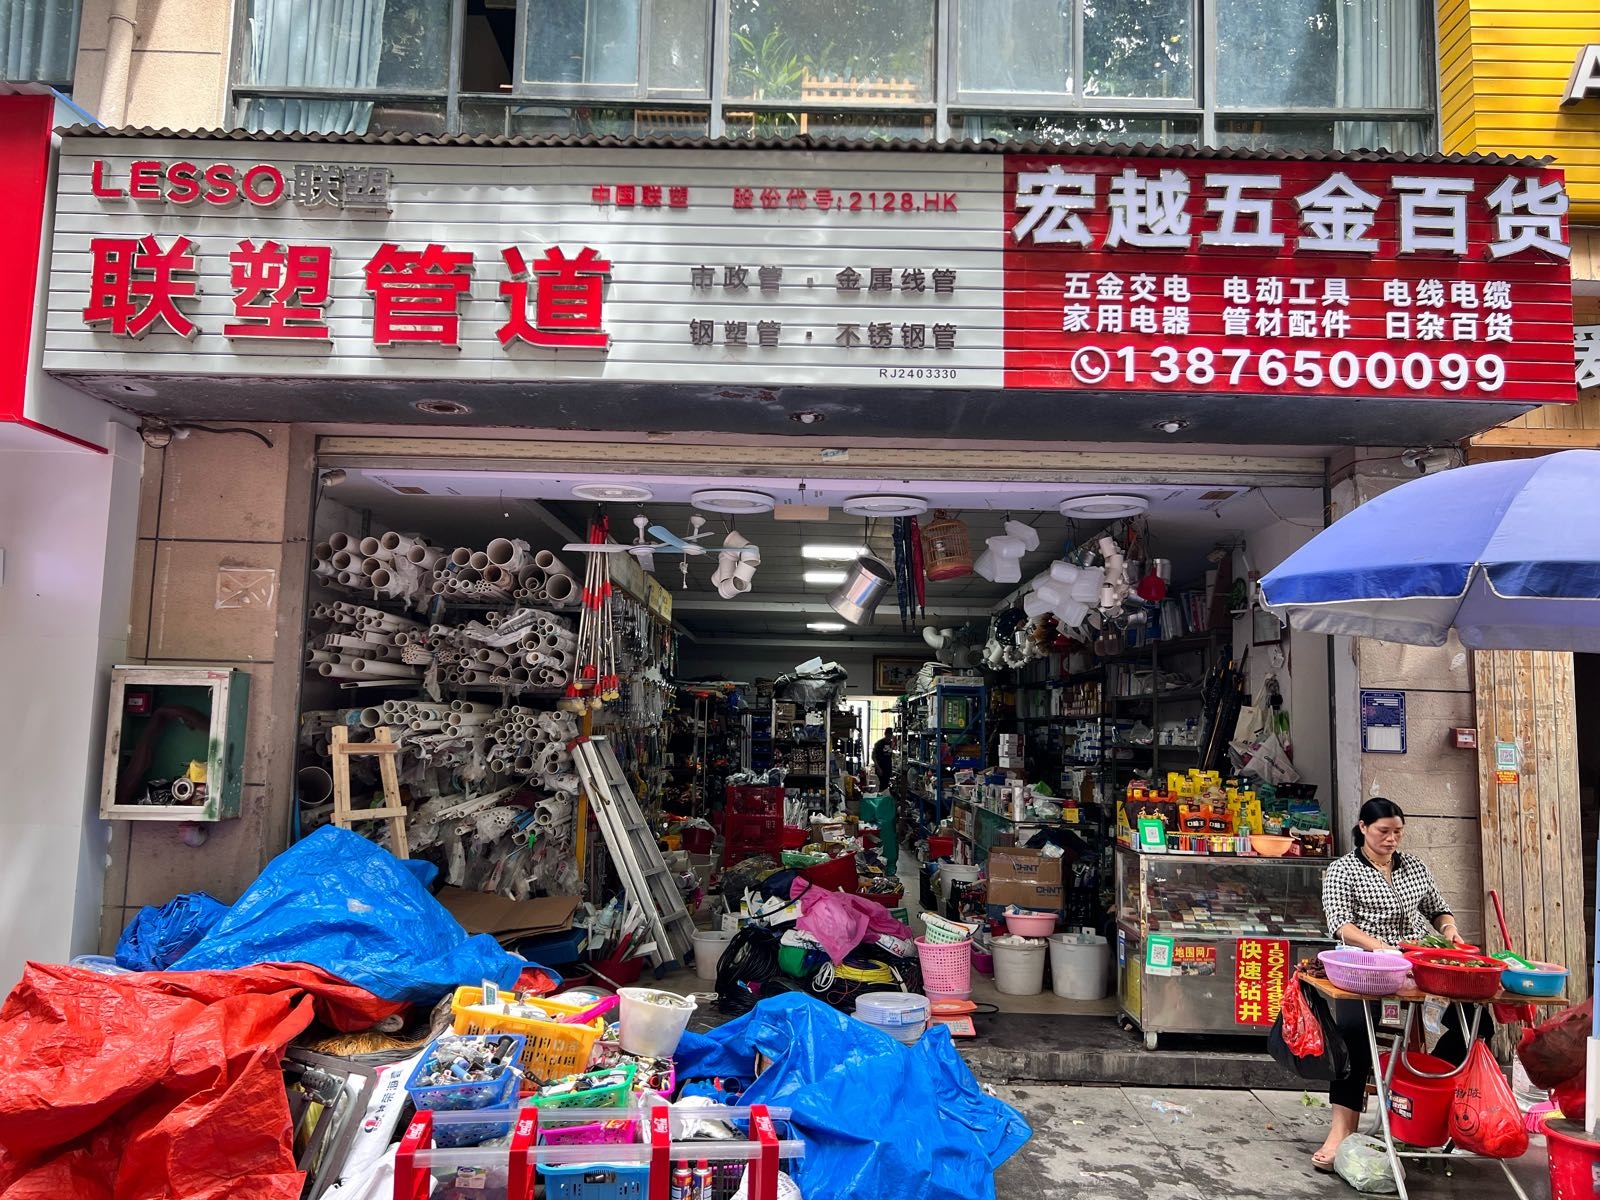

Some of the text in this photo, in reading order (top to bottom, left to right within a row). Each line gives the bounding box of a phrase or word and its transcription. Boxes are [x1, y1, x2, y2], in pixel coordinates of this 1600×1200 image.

[91, 160, 286, 207] LESSO
[293, 163, 394, 213] 联塑
[591, 184, 689, 209] 中国联塑
[1012, 165, 1572, 263] 宏越五金百货
[82, 233, 614, 351] 联塑管道
[1063, 272, 1513, 311] 五金交电 电动工具 电线电缆
[1062, 303, 1514, 343] 家用电器 管材配件 日杂百货
[879, 368, 957, 379] RJ2403330
[1116, 346, 1506, 392] 13876500099
[1172, 946, 1216, 958] 地围网厂
[1238, 940, 1262, 1022] 快速钻井
